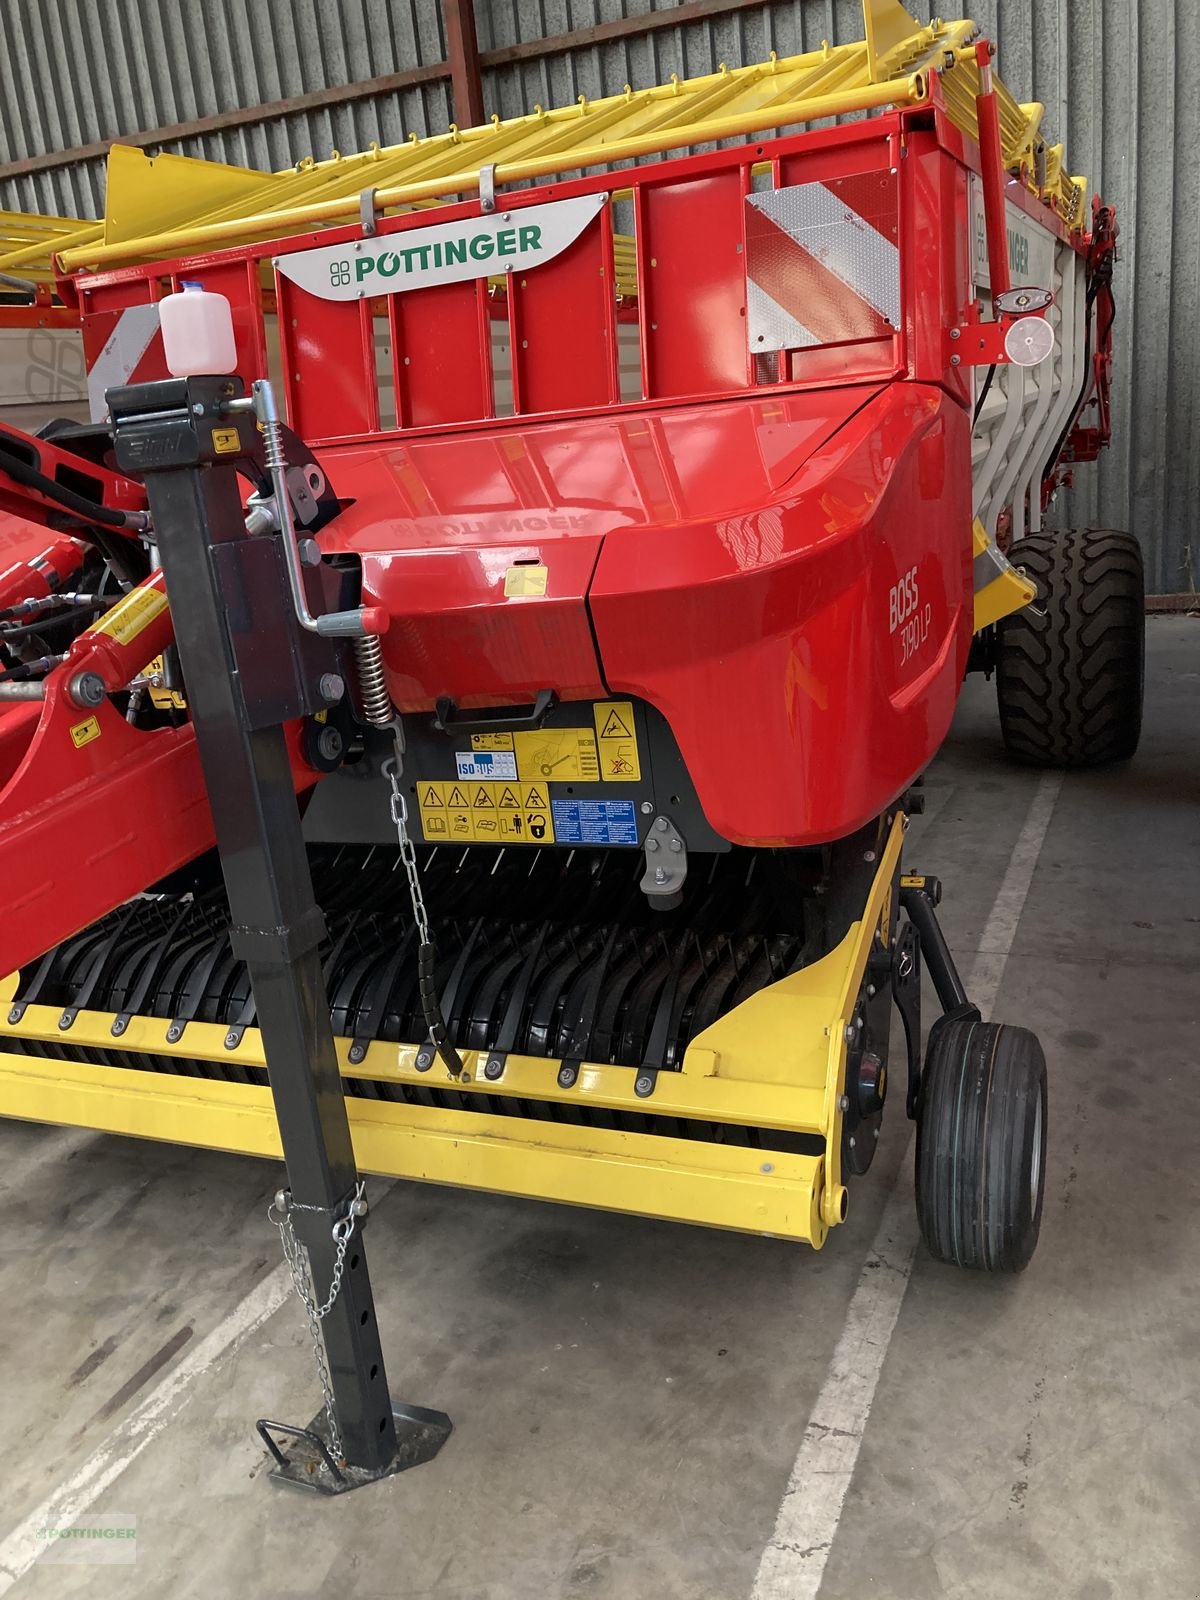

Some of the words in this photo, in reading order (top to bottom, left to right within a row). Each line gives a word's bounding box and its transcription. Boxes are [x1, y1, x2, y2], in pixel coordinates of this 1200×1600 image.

[354, 225, 542, 282] PÖTTINGER
[890, 566, 918, 634] BOSS
[901, 615, 919, 666] 3190
[921, 603, 931, 642] LP
